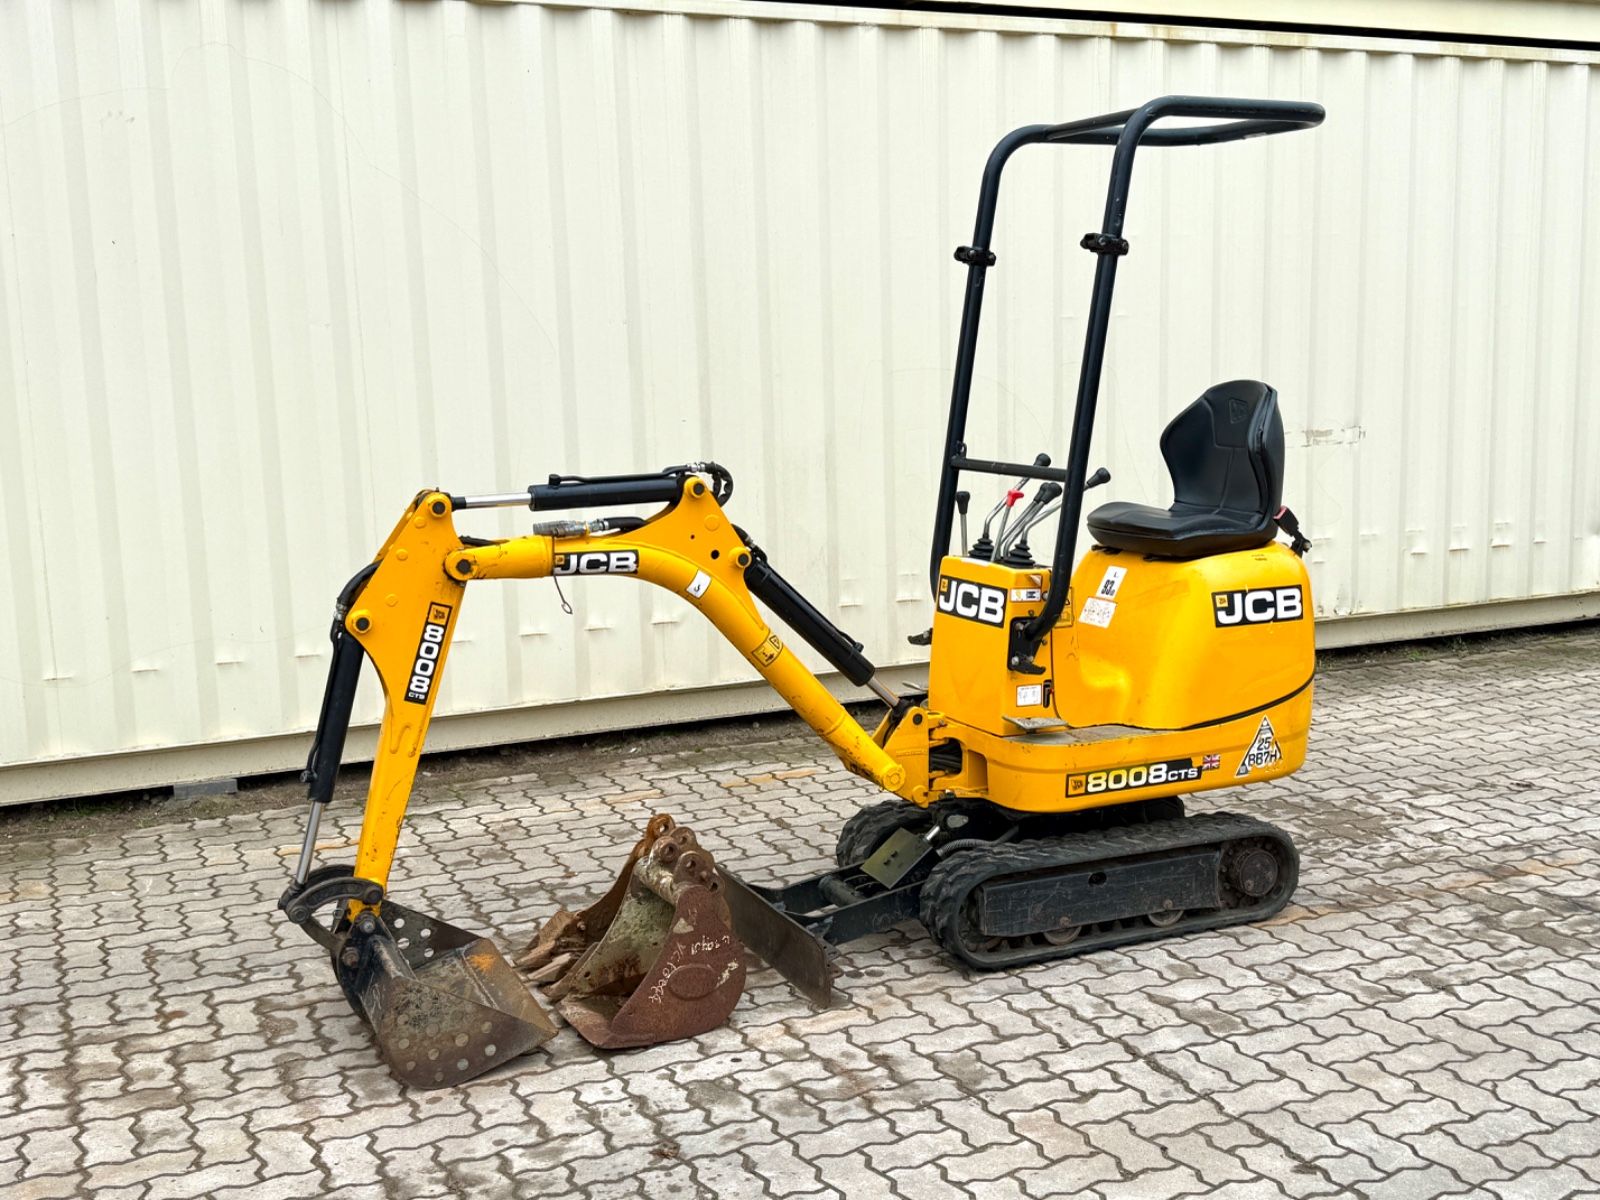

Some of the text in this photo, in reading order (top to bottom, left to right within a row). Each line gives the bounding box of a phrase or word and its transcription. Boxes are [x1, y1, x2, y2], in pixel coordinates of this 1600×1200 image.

[553, 551, 637, 575] JCB
[938, 580, 1005, 624] JCB
[1216, 587, 1302, 625] JCB
[409, 624, 445, 693] 8008
[1257, 736, 1272, 751] 25
